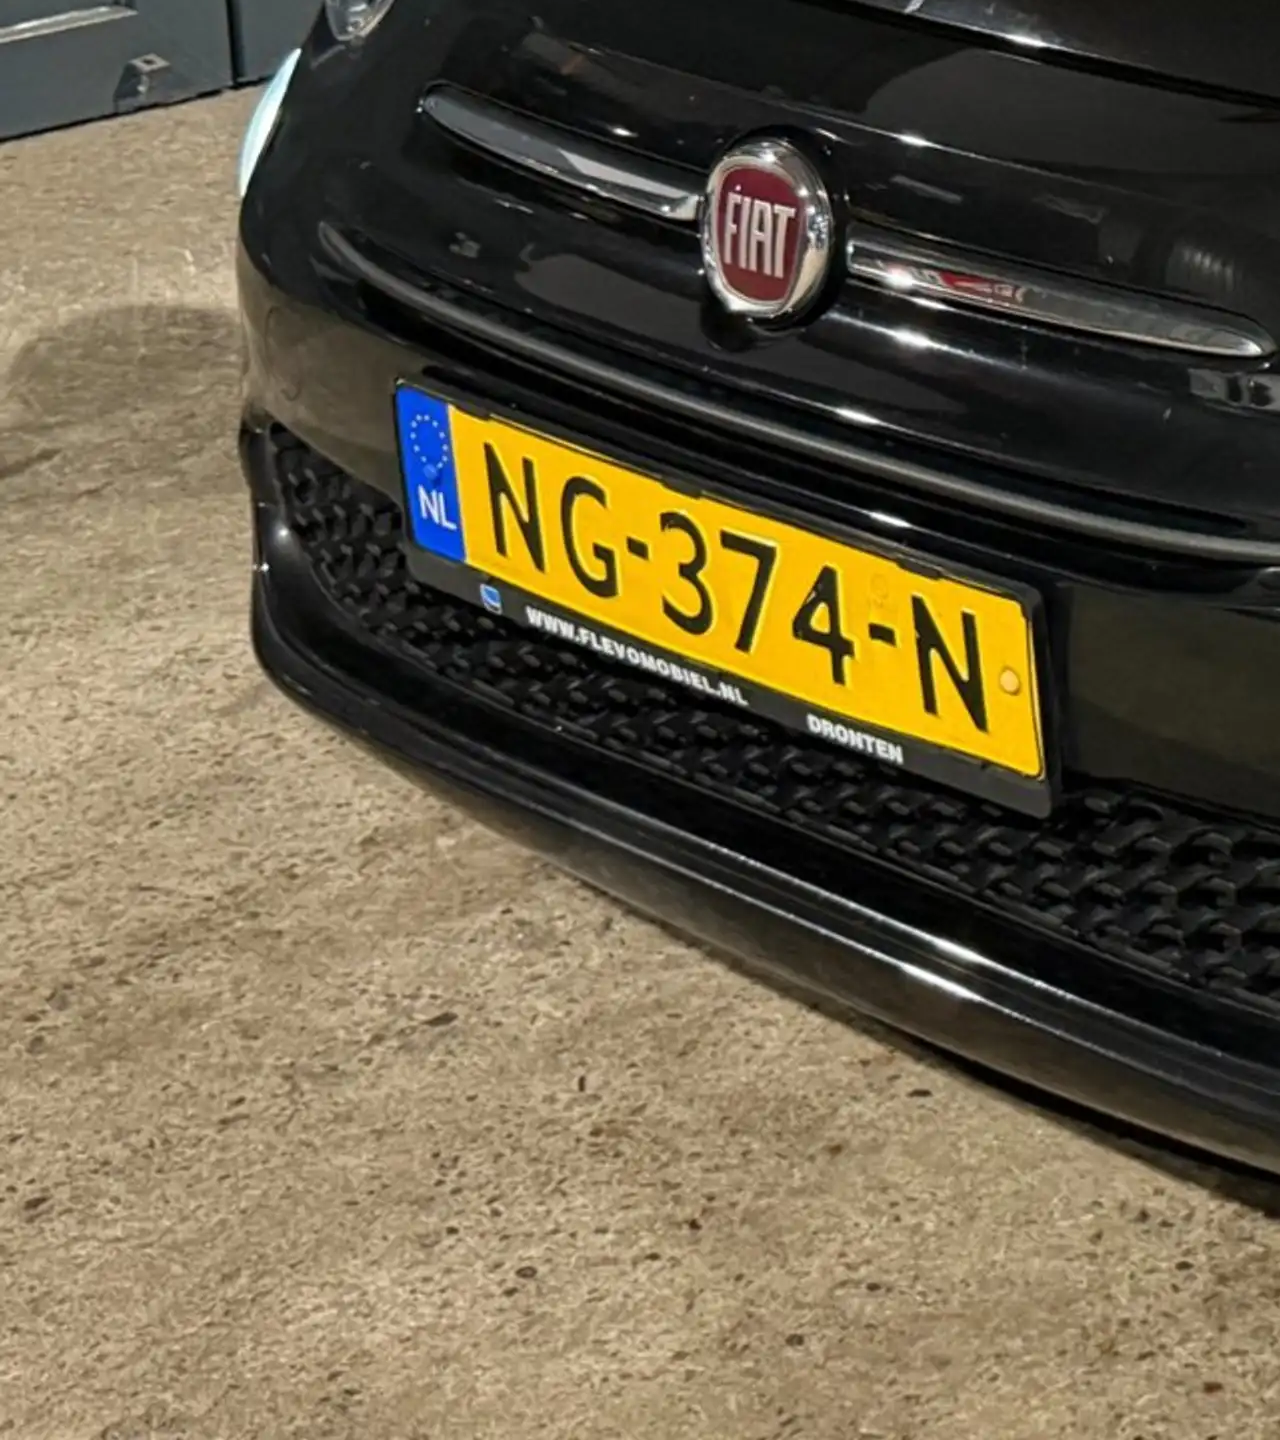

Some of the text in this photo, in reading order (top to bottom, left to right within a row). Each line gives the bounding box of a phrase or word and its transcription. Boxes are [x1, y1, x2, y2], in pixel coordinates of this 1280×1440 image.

[723, 191, 796, 279] FIAT
[418, 483, 458, 530] NL
[483, 441, 989, 733] NG-374-N
[525, 605, 904, 764] WWW.FLEVOMOBIEL.NL DRONTEN
